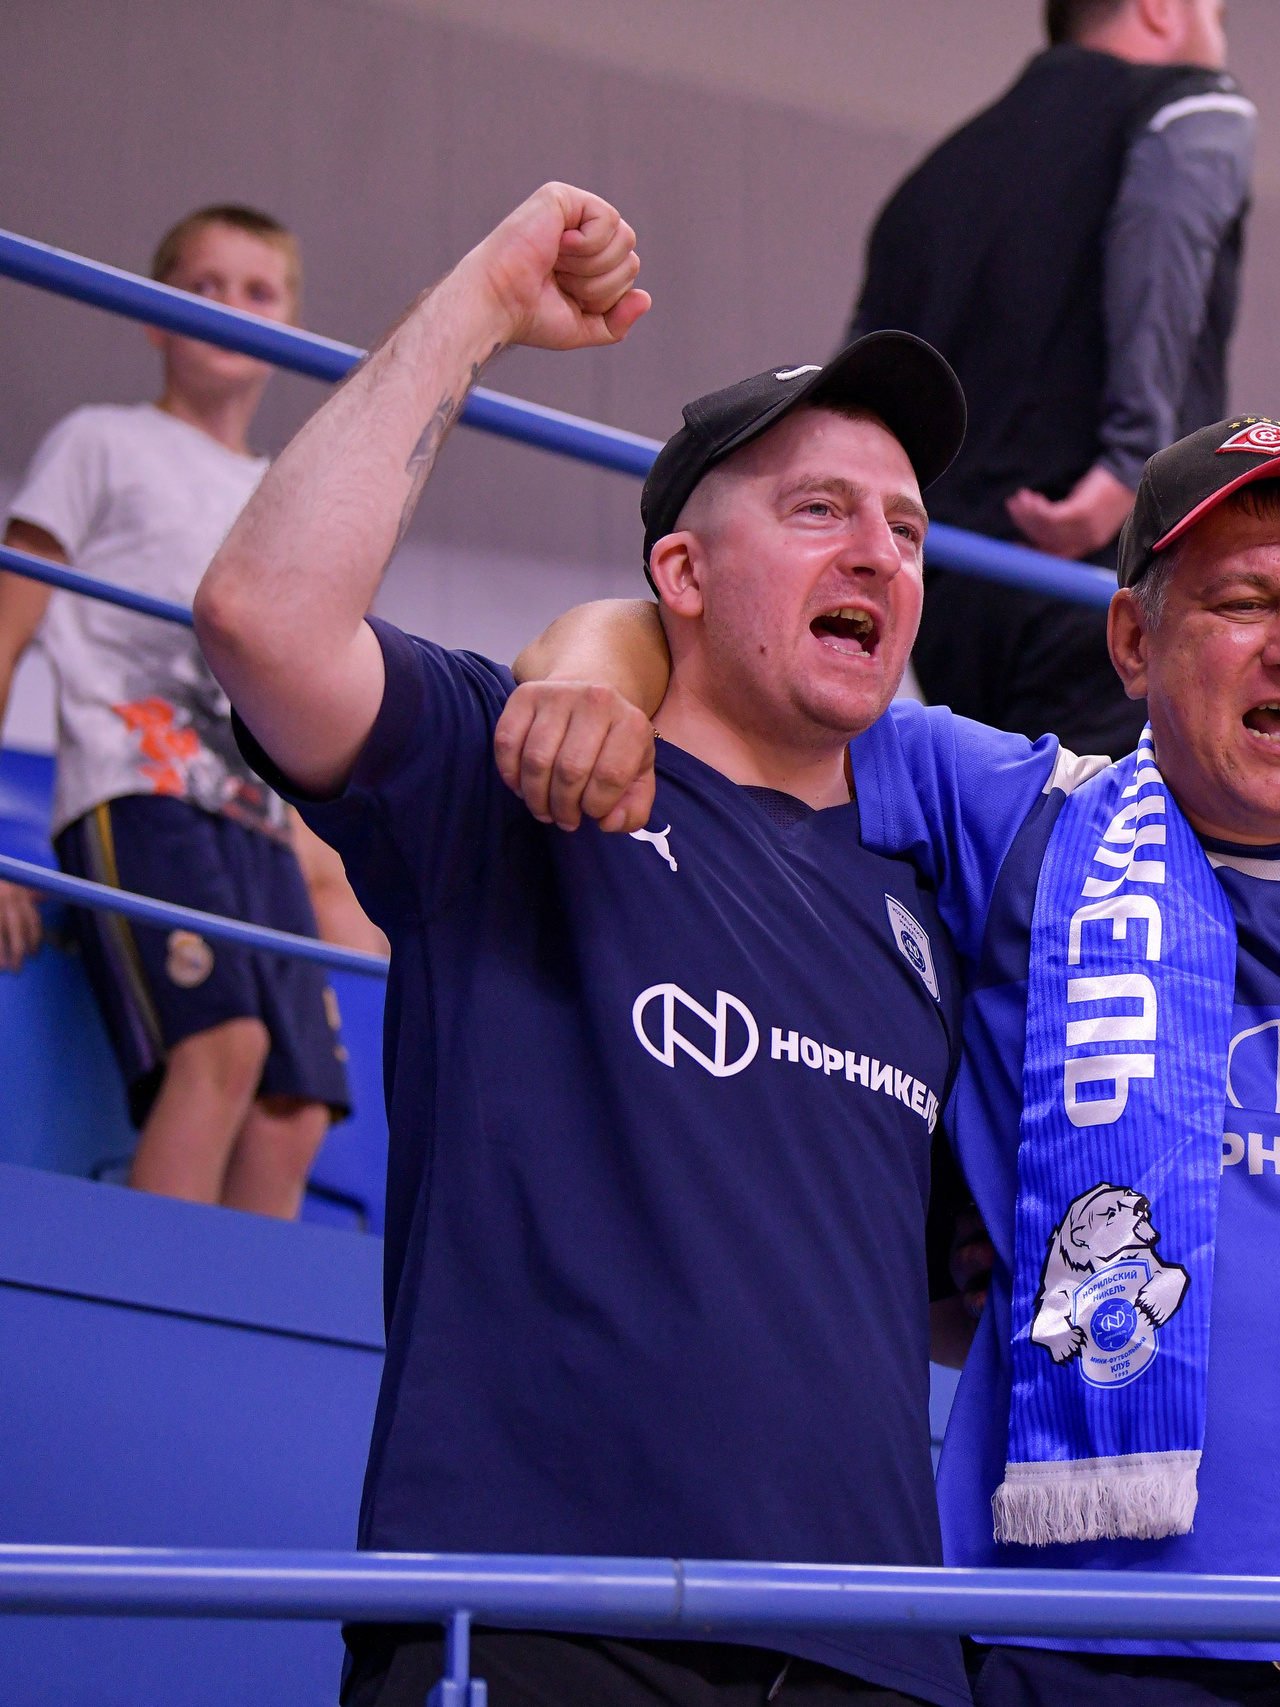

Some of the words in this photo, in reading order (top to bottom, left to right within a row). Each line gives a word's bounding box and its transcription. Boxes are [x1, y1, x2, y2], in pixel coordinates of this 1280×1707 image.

[771, 1026, 940, 1135] НОРНИКЕЛЬ
[1082, 1270, 1138, 1299] НОРИЛЬСКИЙ
[1092, 1284, 1126, 1302] НИКЕЛЬ
[1090, 1336, 1147, 1364] МИНИ-ФУТБОЛЬНЫЙ
[1110, 1360, 1131, 1373] КЛУБ
